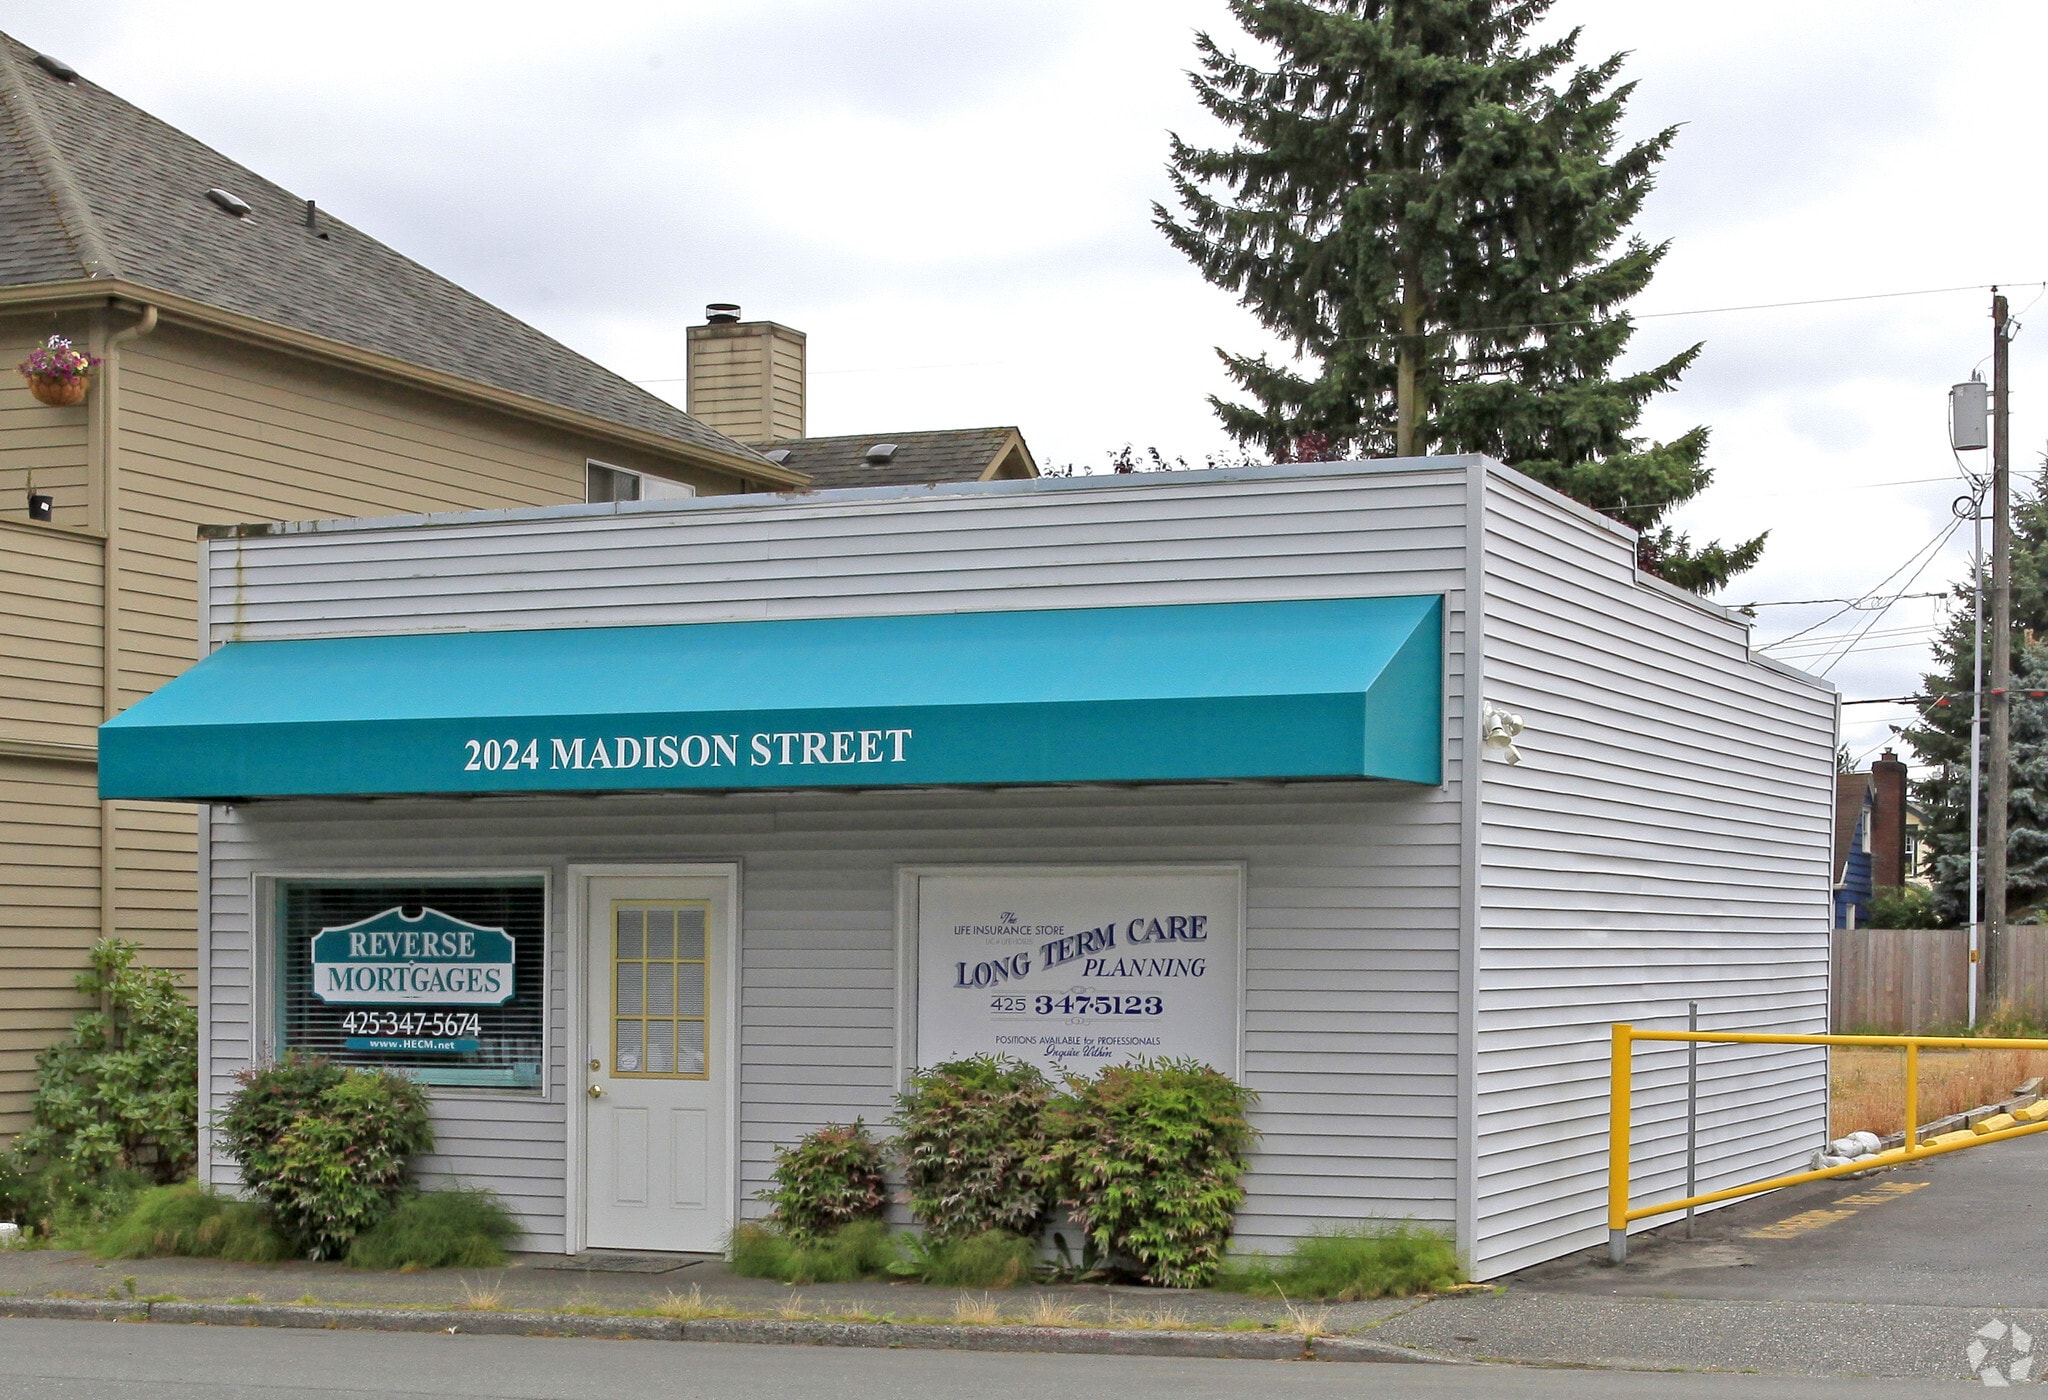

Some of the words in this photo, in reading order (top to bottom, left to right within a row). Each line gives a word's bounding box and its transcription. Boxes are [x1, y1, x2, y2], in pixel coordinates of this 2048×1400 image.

[464, 738, 539, 771] 2024
[549, 734, 740, 770] MADISON
[750, 729, 913, 766] STREET
[1000, 911, 1018, 924] The
[954, 925, 971, 935] LIFE
[973, 925, 1032, 935] INSURANCE
[1035, 925, 1065, 935] STORE
[349, 931, 476, 958] REVERSE
[954, 952, 1031, 988] LONG
[1039, 922, 1116, 971] TERM
[1126, 915, 1208, 945] CARE
[1082, 958, 1207, 977] PLANNING
[327, 967, 501, 993] MORTGAGES
[991, 998, 1026, 1011] 425
[342, 1011, 482, 1037] 425-347-5674
[369, 1039, 455, 1050] www.HECM.net
[995, 1035, 1037, 1044] POSITIONS
[1039, 1036, 1081, 1045] AVAILABLE
[1083, 1037, 1095, 1045] for
[1098, 1037, 1161, 1045] PROFESSIONALS
[1044, 1044, 1080, 1062] Inquire
[1083, 1045, 1112, 1057] Within
